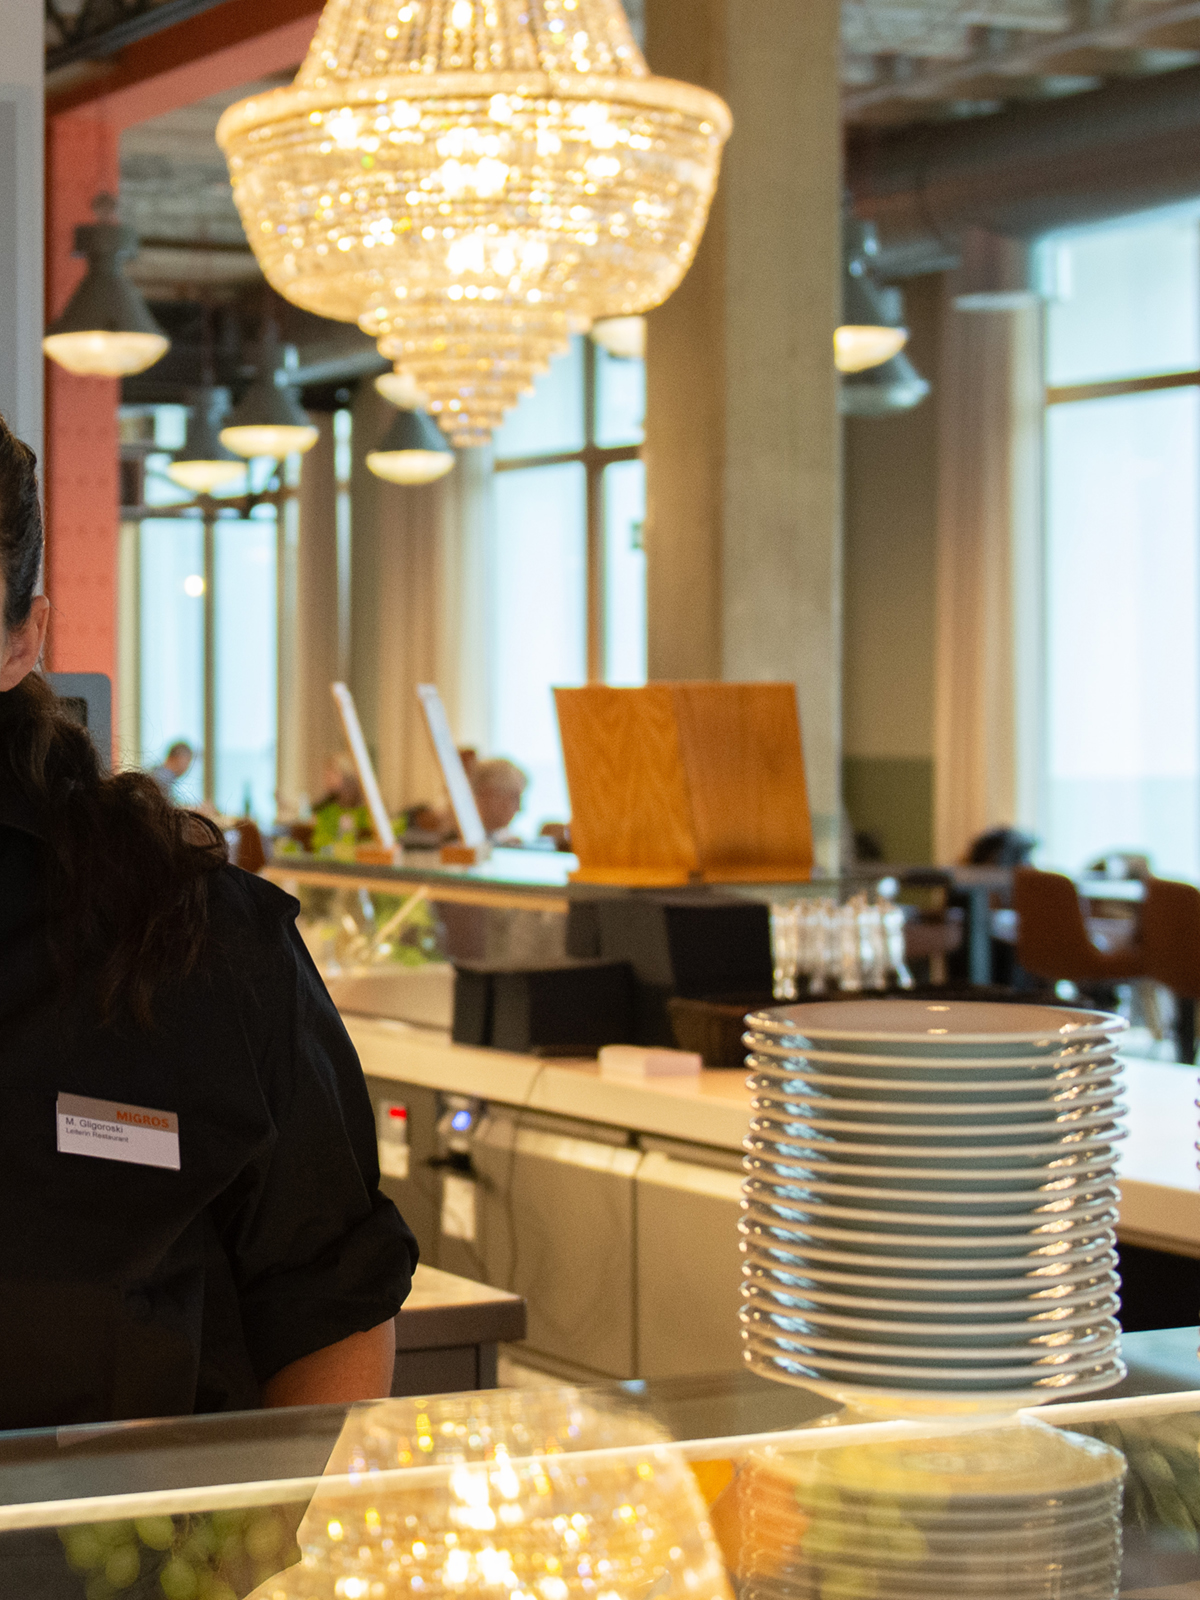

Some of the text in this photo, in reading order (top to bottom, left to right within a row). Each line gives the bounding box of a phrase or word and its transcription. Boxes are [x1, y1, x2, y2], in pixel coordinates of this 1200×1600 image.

[65, 1116, 124, 1133] M. Gligoroski
[116, 1110, 170, 1129] MIGROS
[92, 1131, 129, 1143] Restaurant
